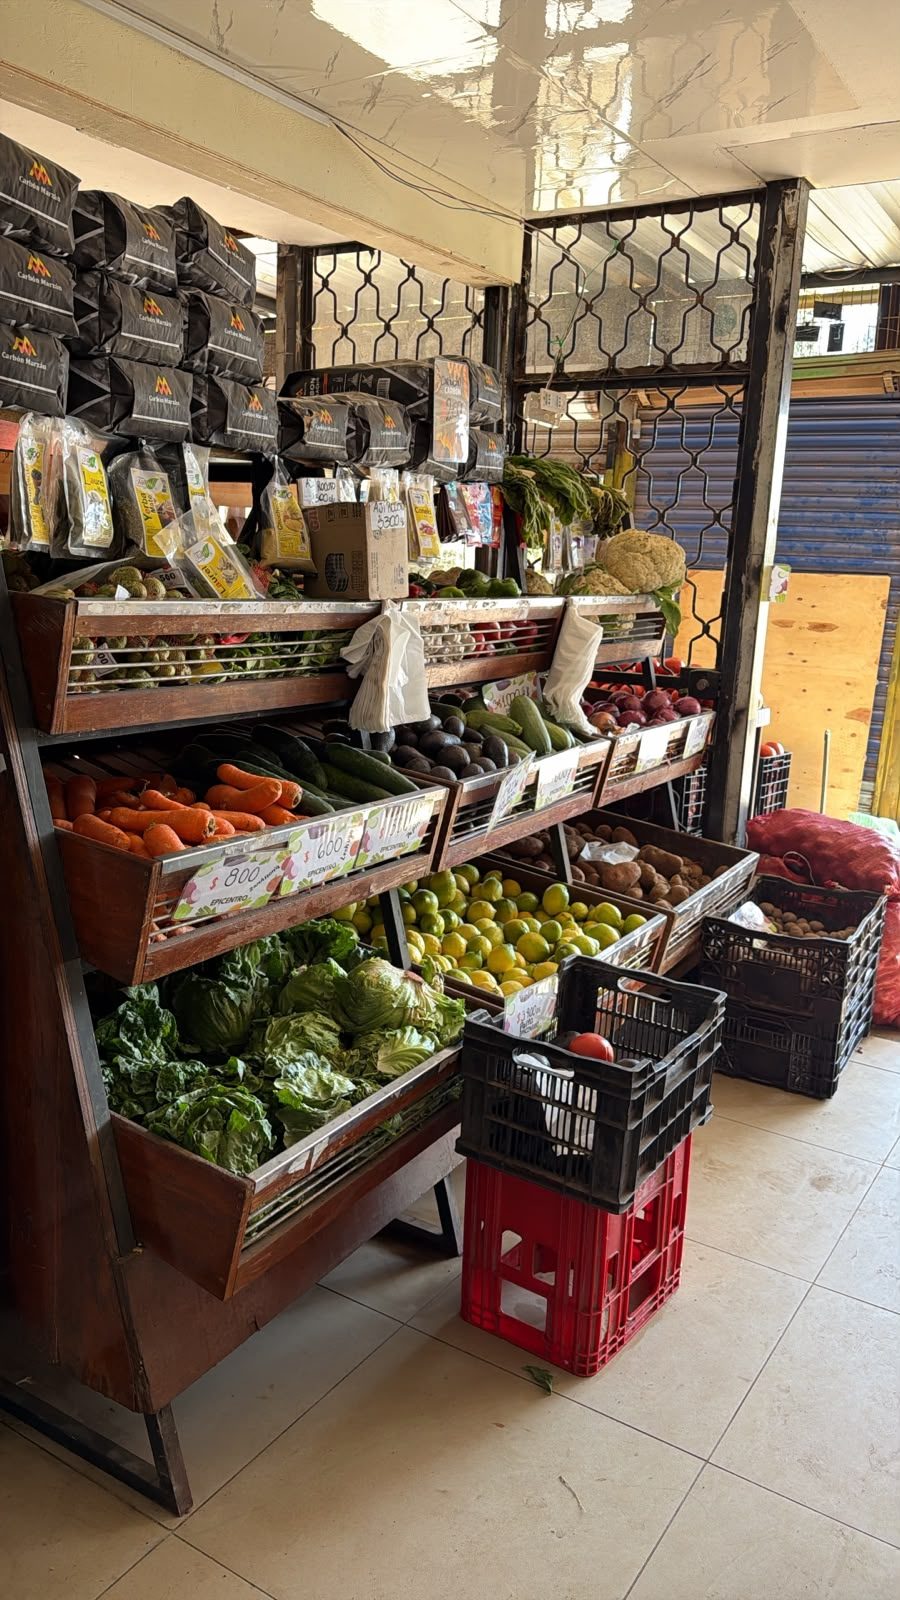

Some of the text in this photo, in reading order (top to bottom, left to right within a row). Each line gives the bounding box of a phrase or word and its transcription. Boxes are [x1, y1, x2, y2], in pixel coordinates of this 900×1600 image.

[1, 351, 25, 364] Carbón
[201, 565, 227, 595] Laurel
[317, 837, 343, 859] 600
[209, 866, 261, 890] $ 800
[307, 862, 337, 877] EPICENTRO
[210, 894, 248, 906] EPICENTRO
